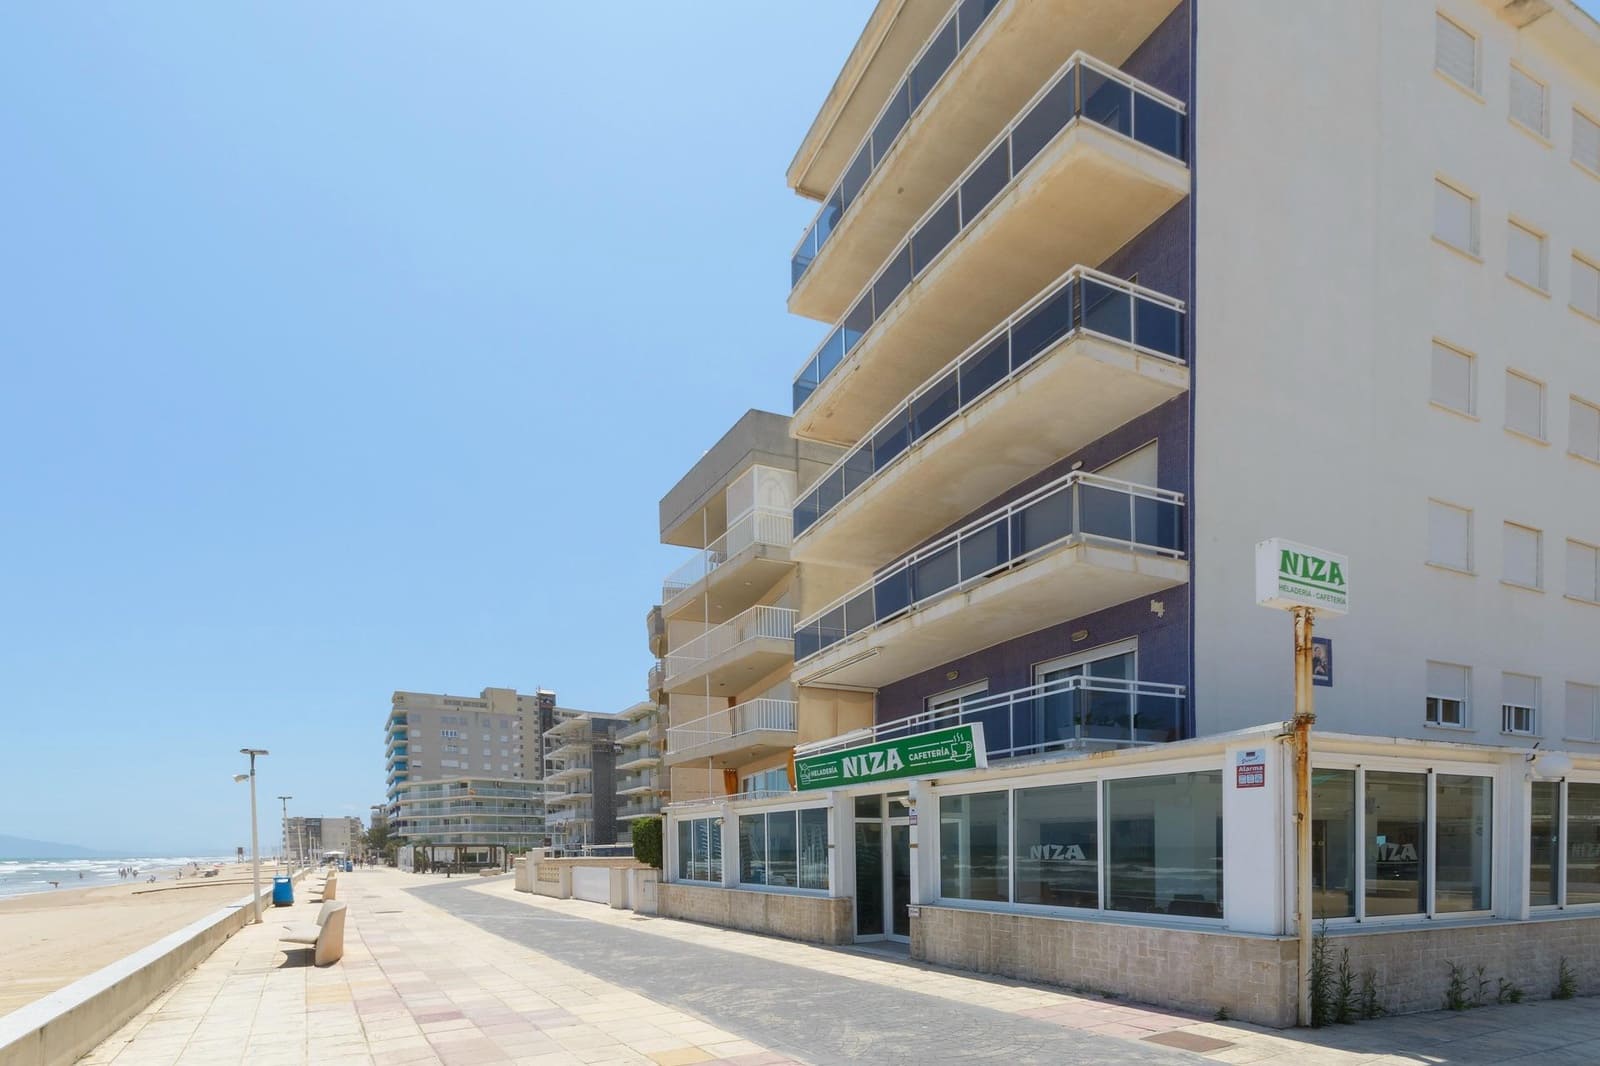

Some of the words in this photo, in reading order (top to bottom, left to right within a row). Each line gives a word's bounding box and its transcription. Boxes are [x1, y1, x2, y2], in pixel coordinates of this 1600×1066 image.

[1279, 549, 1346, 586] NIZA
[841, 747, 904, 778] NIZA
[908, 747, 950, 762] CAFETERÍA
[1239, 765, 1264, 773] Alarma
[1030, 844, 1086, 860] NIZA
